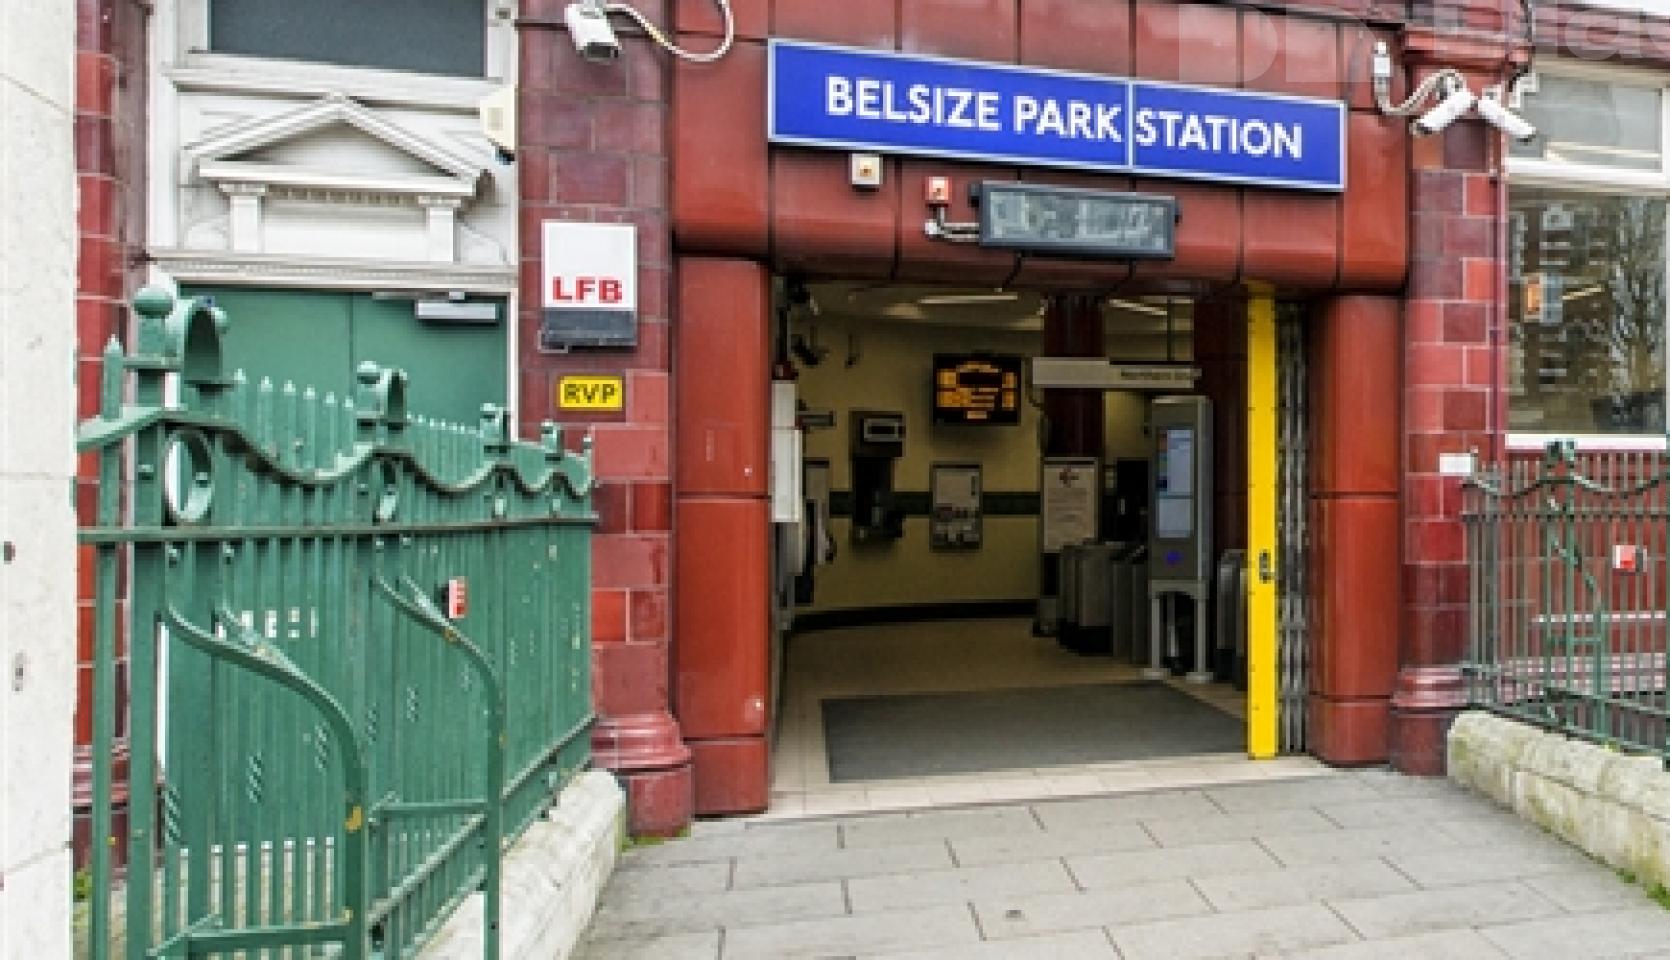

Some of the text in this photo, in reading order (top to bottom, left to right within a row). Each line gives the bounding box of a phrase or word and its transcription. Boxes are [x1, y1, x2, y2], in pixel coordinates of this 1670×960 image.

[824, 74, 1303, 160] BELSIZE PARK STATION
[551, 275, 624, 304] LFB
[562, 382, 617, 404] RVP
